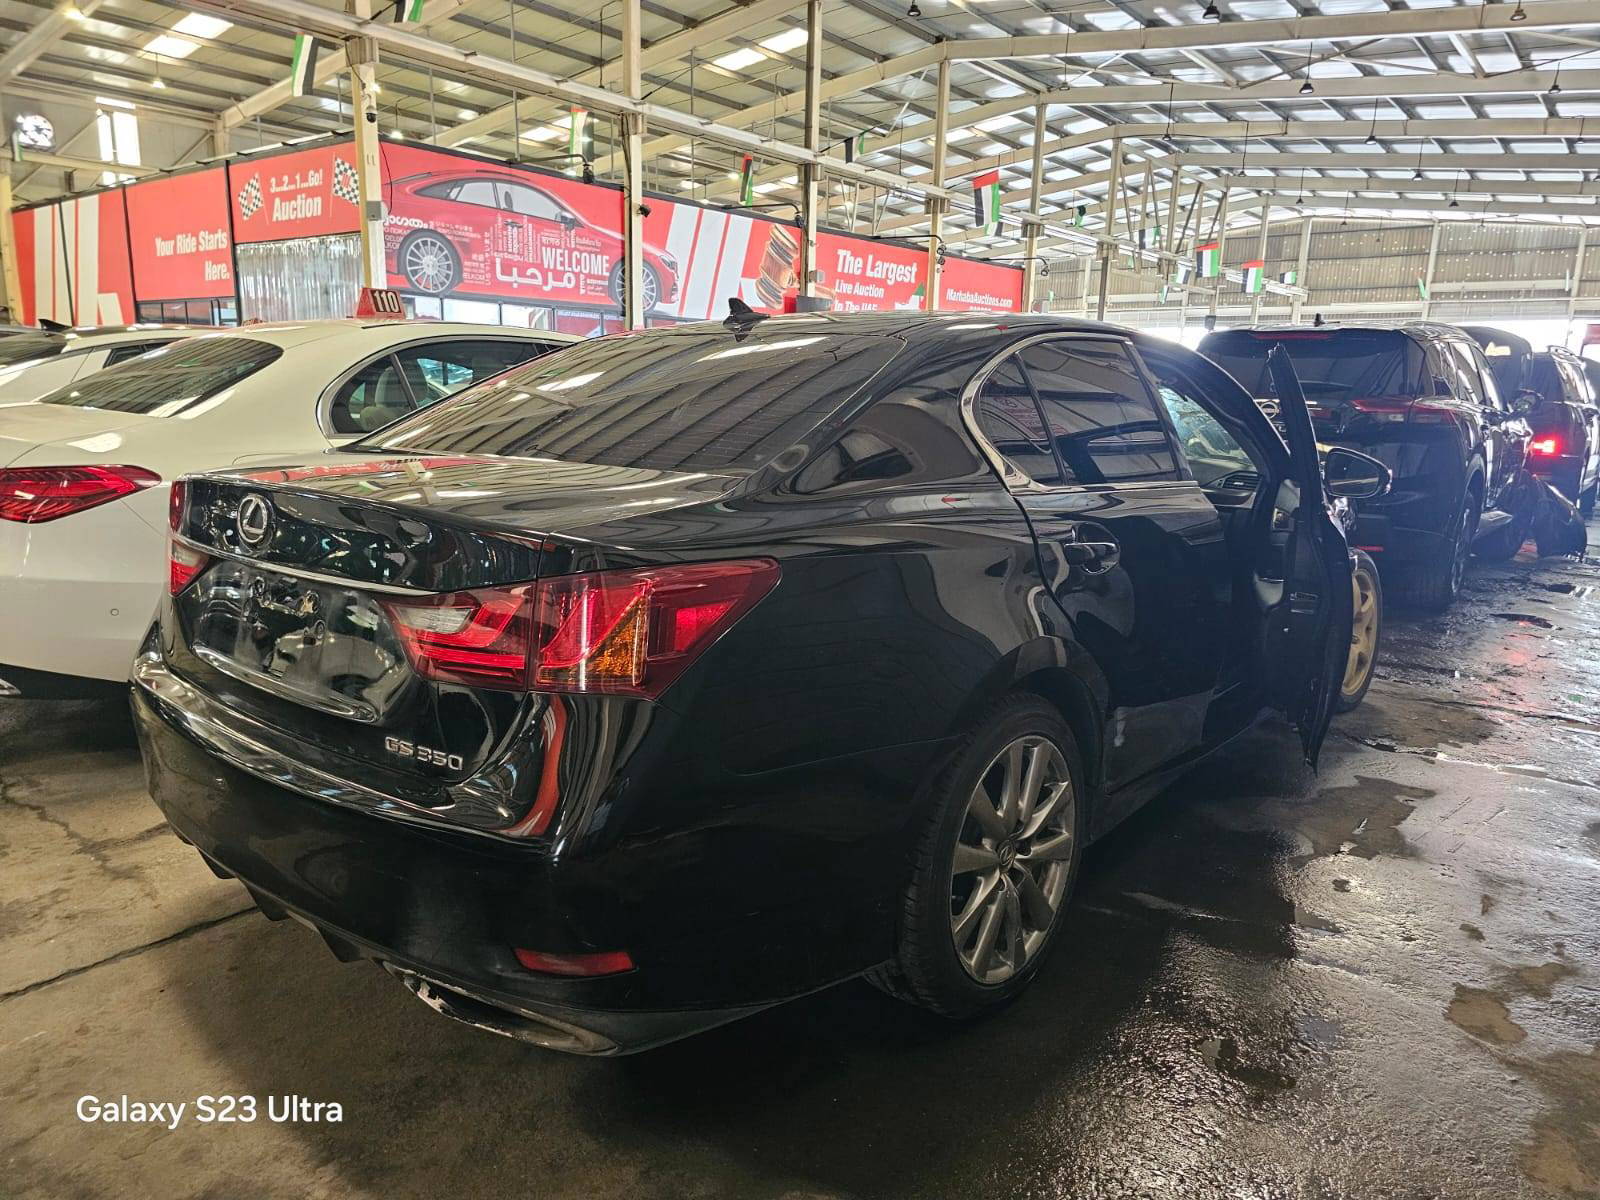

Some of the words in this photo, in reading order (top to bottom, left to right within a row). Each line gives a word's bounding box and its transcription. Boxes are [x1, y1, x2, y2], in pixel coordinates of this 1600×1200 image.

[272, 194, 322, 222] Auction
[155, 236, 175, 257] Your
[176, 233, 197, 254] Ride
[198, 228, 228, 251] Starts
[204, 260, 230, 281] Here.
[495, 256, 576, 292] مرحبا
[541, 246, 610, 277] WELCOME
[837, 248, 863, 275] The
[865, 254, 918, 286] Largest
[374, 290, 400, 313] 110
[834, 279, 853, 294] Live
[853, 282, 885, 298] Auction
[385, 736, 414, 757] GS
[416, 744, 464, 771] 350
